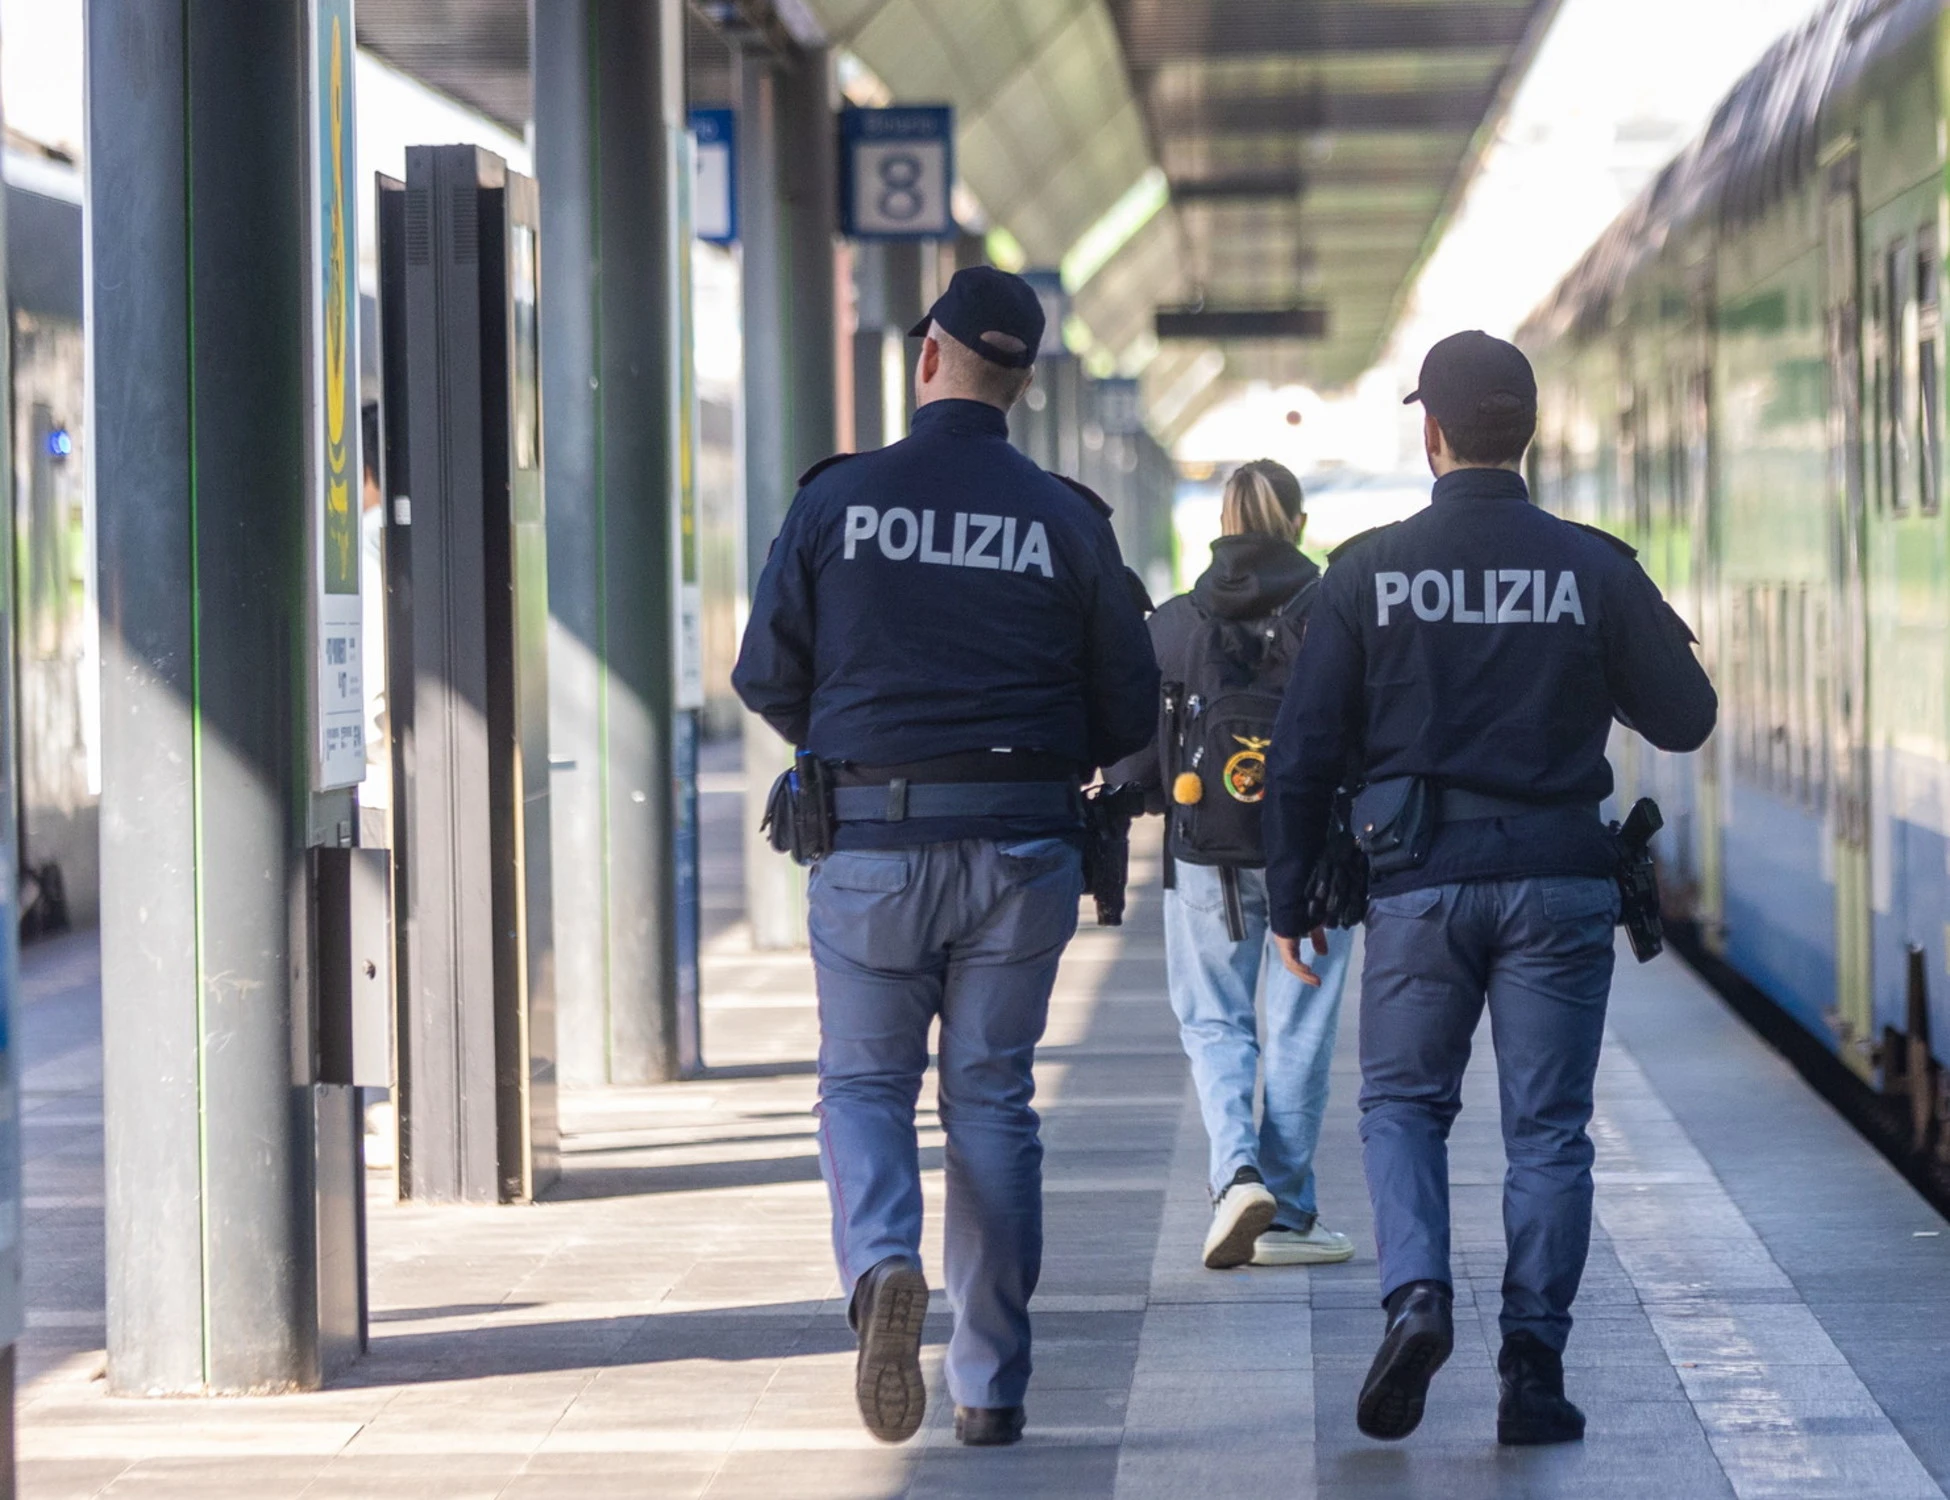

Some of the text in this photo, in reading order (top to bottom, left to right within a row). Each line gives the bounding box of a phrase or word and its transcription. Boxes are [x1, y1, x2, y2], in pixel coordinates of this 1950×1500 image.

[878, 154, 923, 221] 8
[844, 505, 1054, 578] POLIZIA
[1375, 569, 1586, 626] POLIZIA
